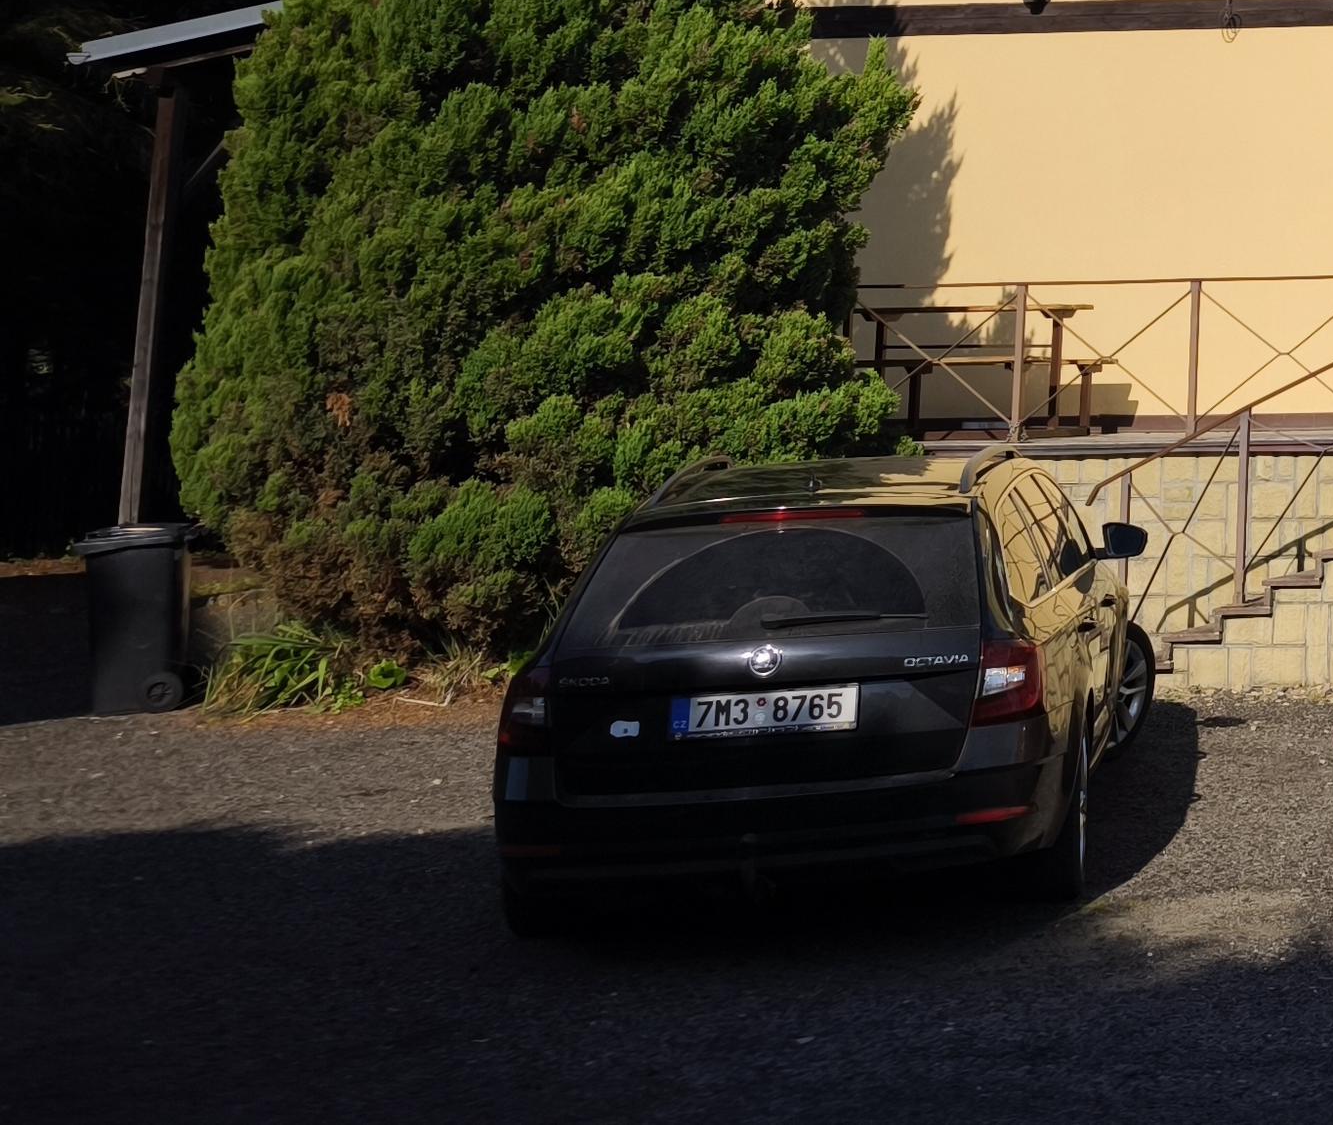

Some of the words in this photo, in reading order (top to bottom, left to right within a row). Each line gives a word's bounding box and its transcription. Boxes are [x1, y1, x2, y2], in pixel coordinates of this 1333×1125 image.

[903, 654, 969, 667] OCTAVIA
[695, 698, 750, 729] 7M3
[772, 692, 844, 722] 8765
[672, 720, 688, 729] CZ
